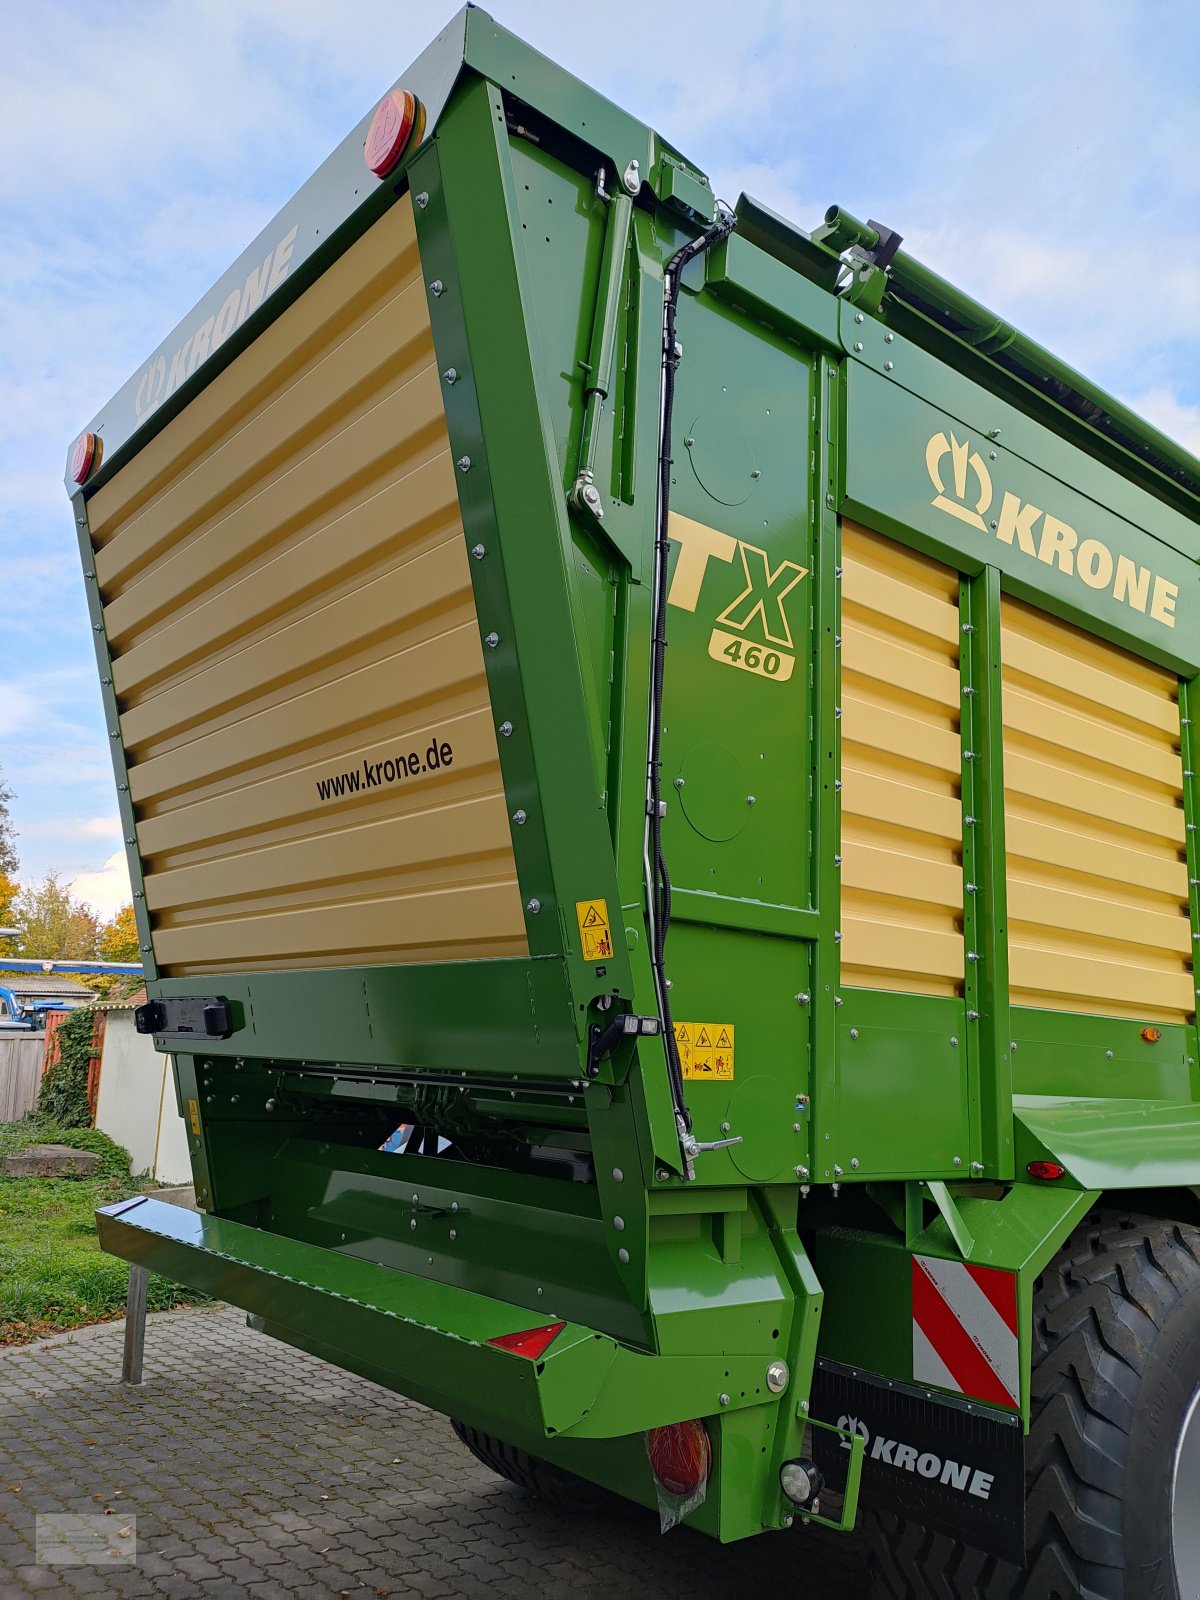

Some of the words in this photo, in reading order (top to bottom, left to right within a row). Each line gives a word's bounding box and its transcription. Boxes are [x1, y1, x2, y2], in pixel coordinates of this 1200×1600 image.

[163, 224, 298, 401] KRONE
[667, 509, 809, 649] TX
[996, 491, 1179, 628] KRONE
[723, 640, 780, 675] 460
[316, 738, 453, 800] www.krone.de
[870, 1435, 995, 1500] KRONE
